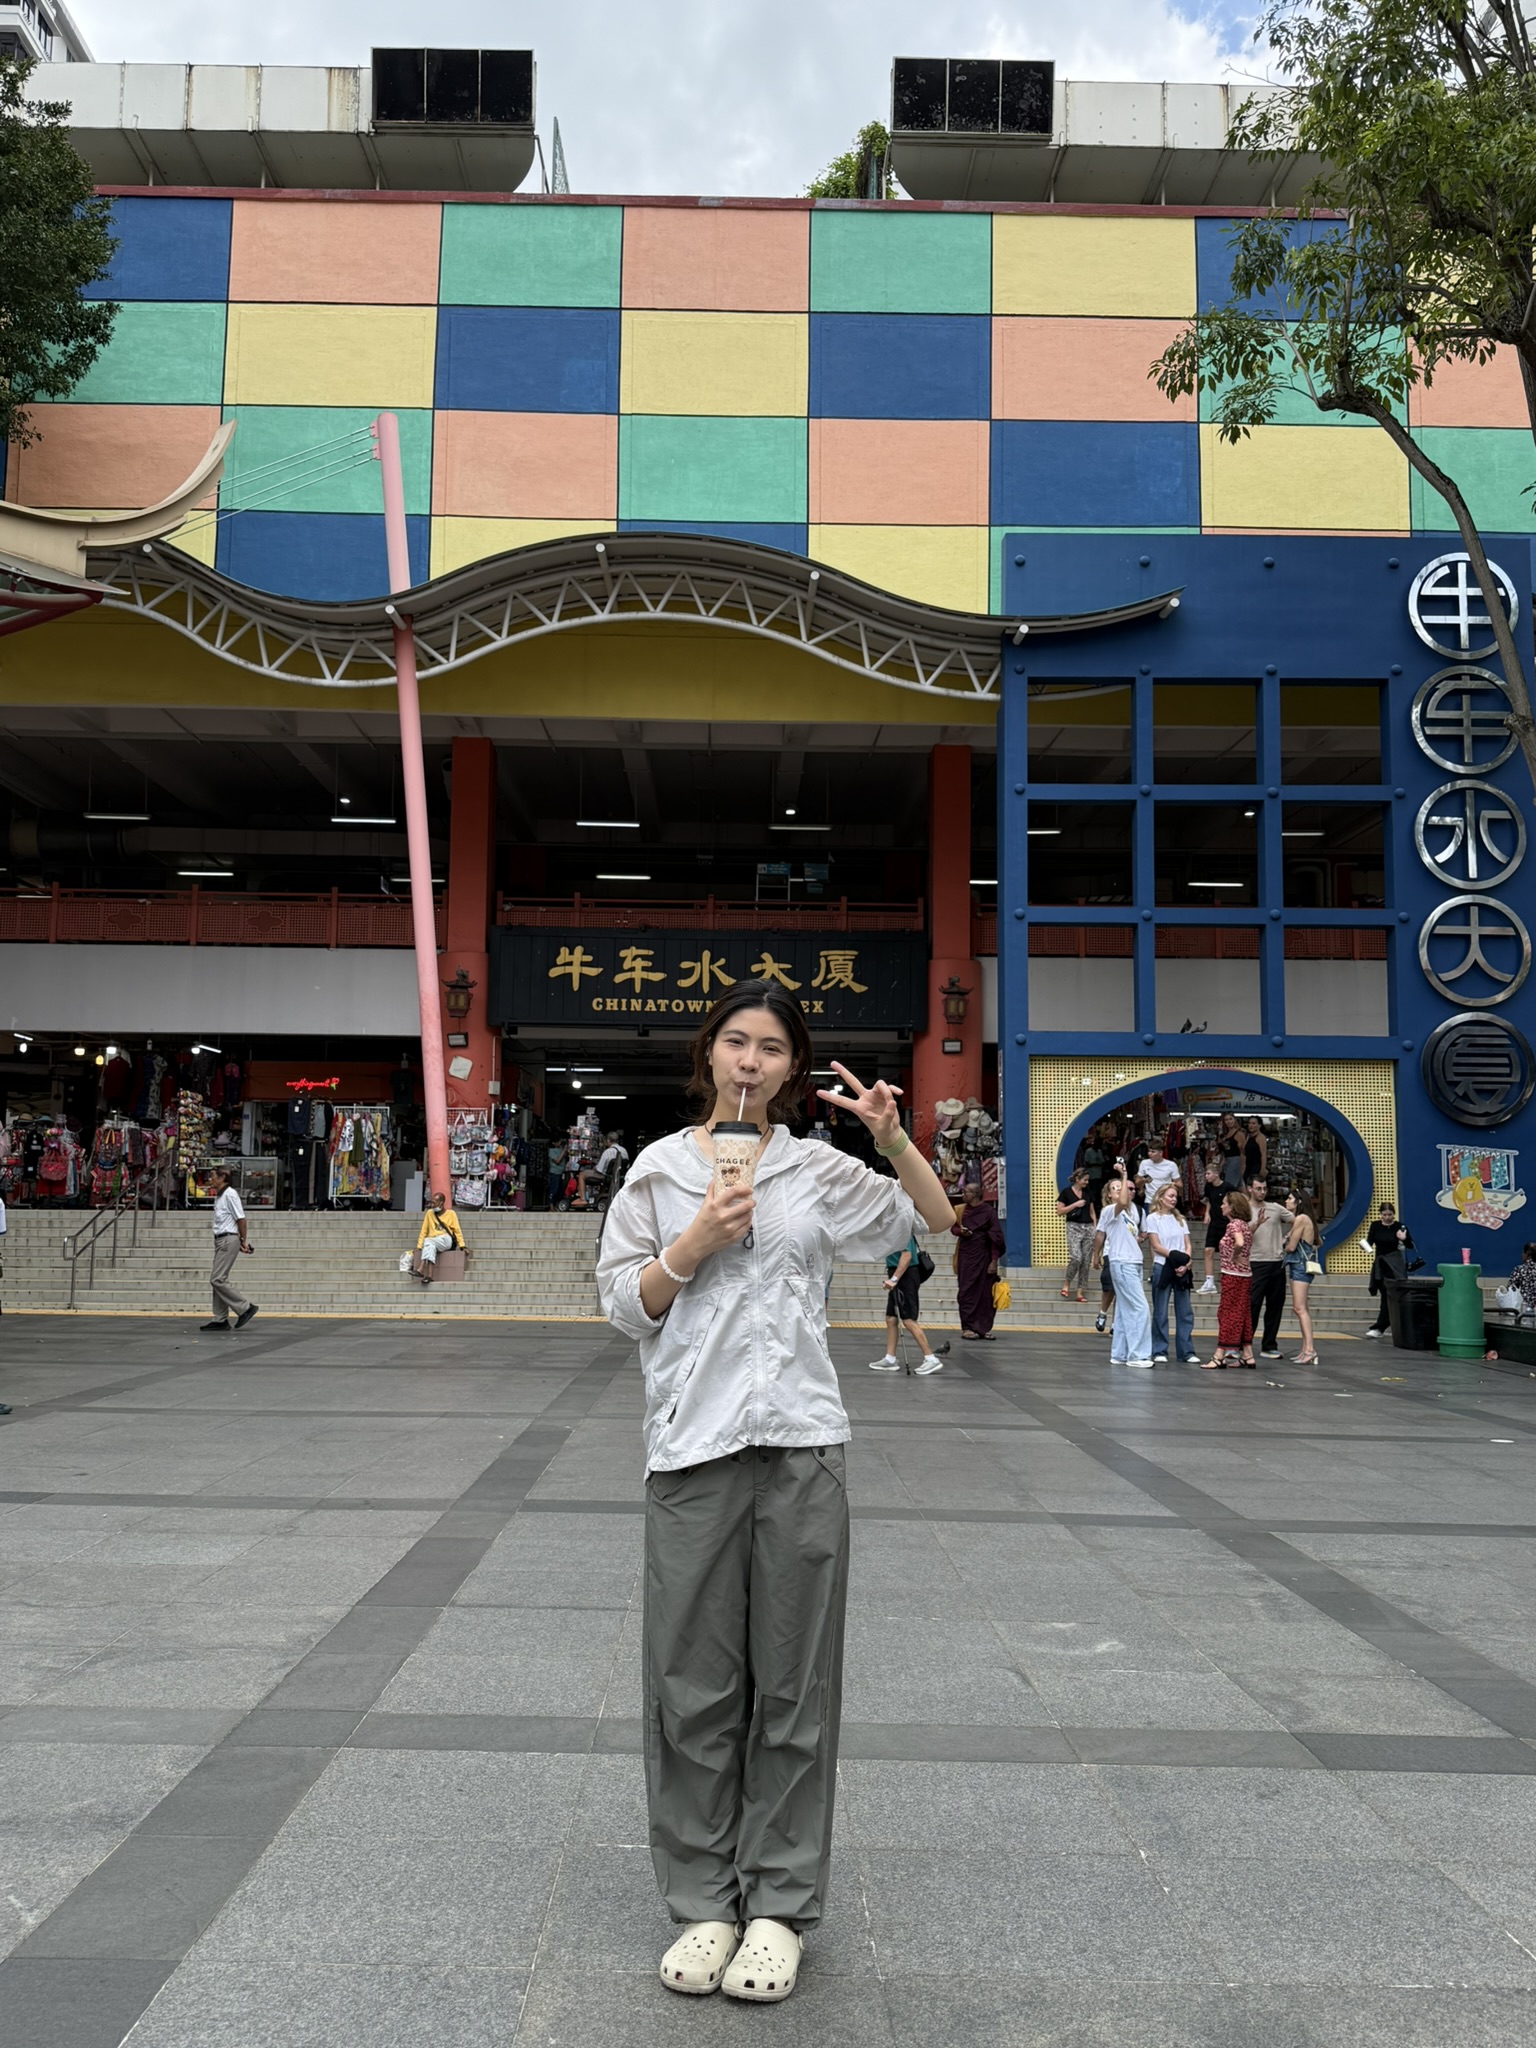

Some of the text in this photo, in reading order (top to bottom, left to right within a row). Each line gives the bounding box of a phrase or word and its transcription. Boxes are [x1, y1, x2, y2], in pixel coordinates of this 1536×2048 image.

[548, 945, 869, 993] 牛车水大厦
[1220, 1101, 1232, 1109] Ju
